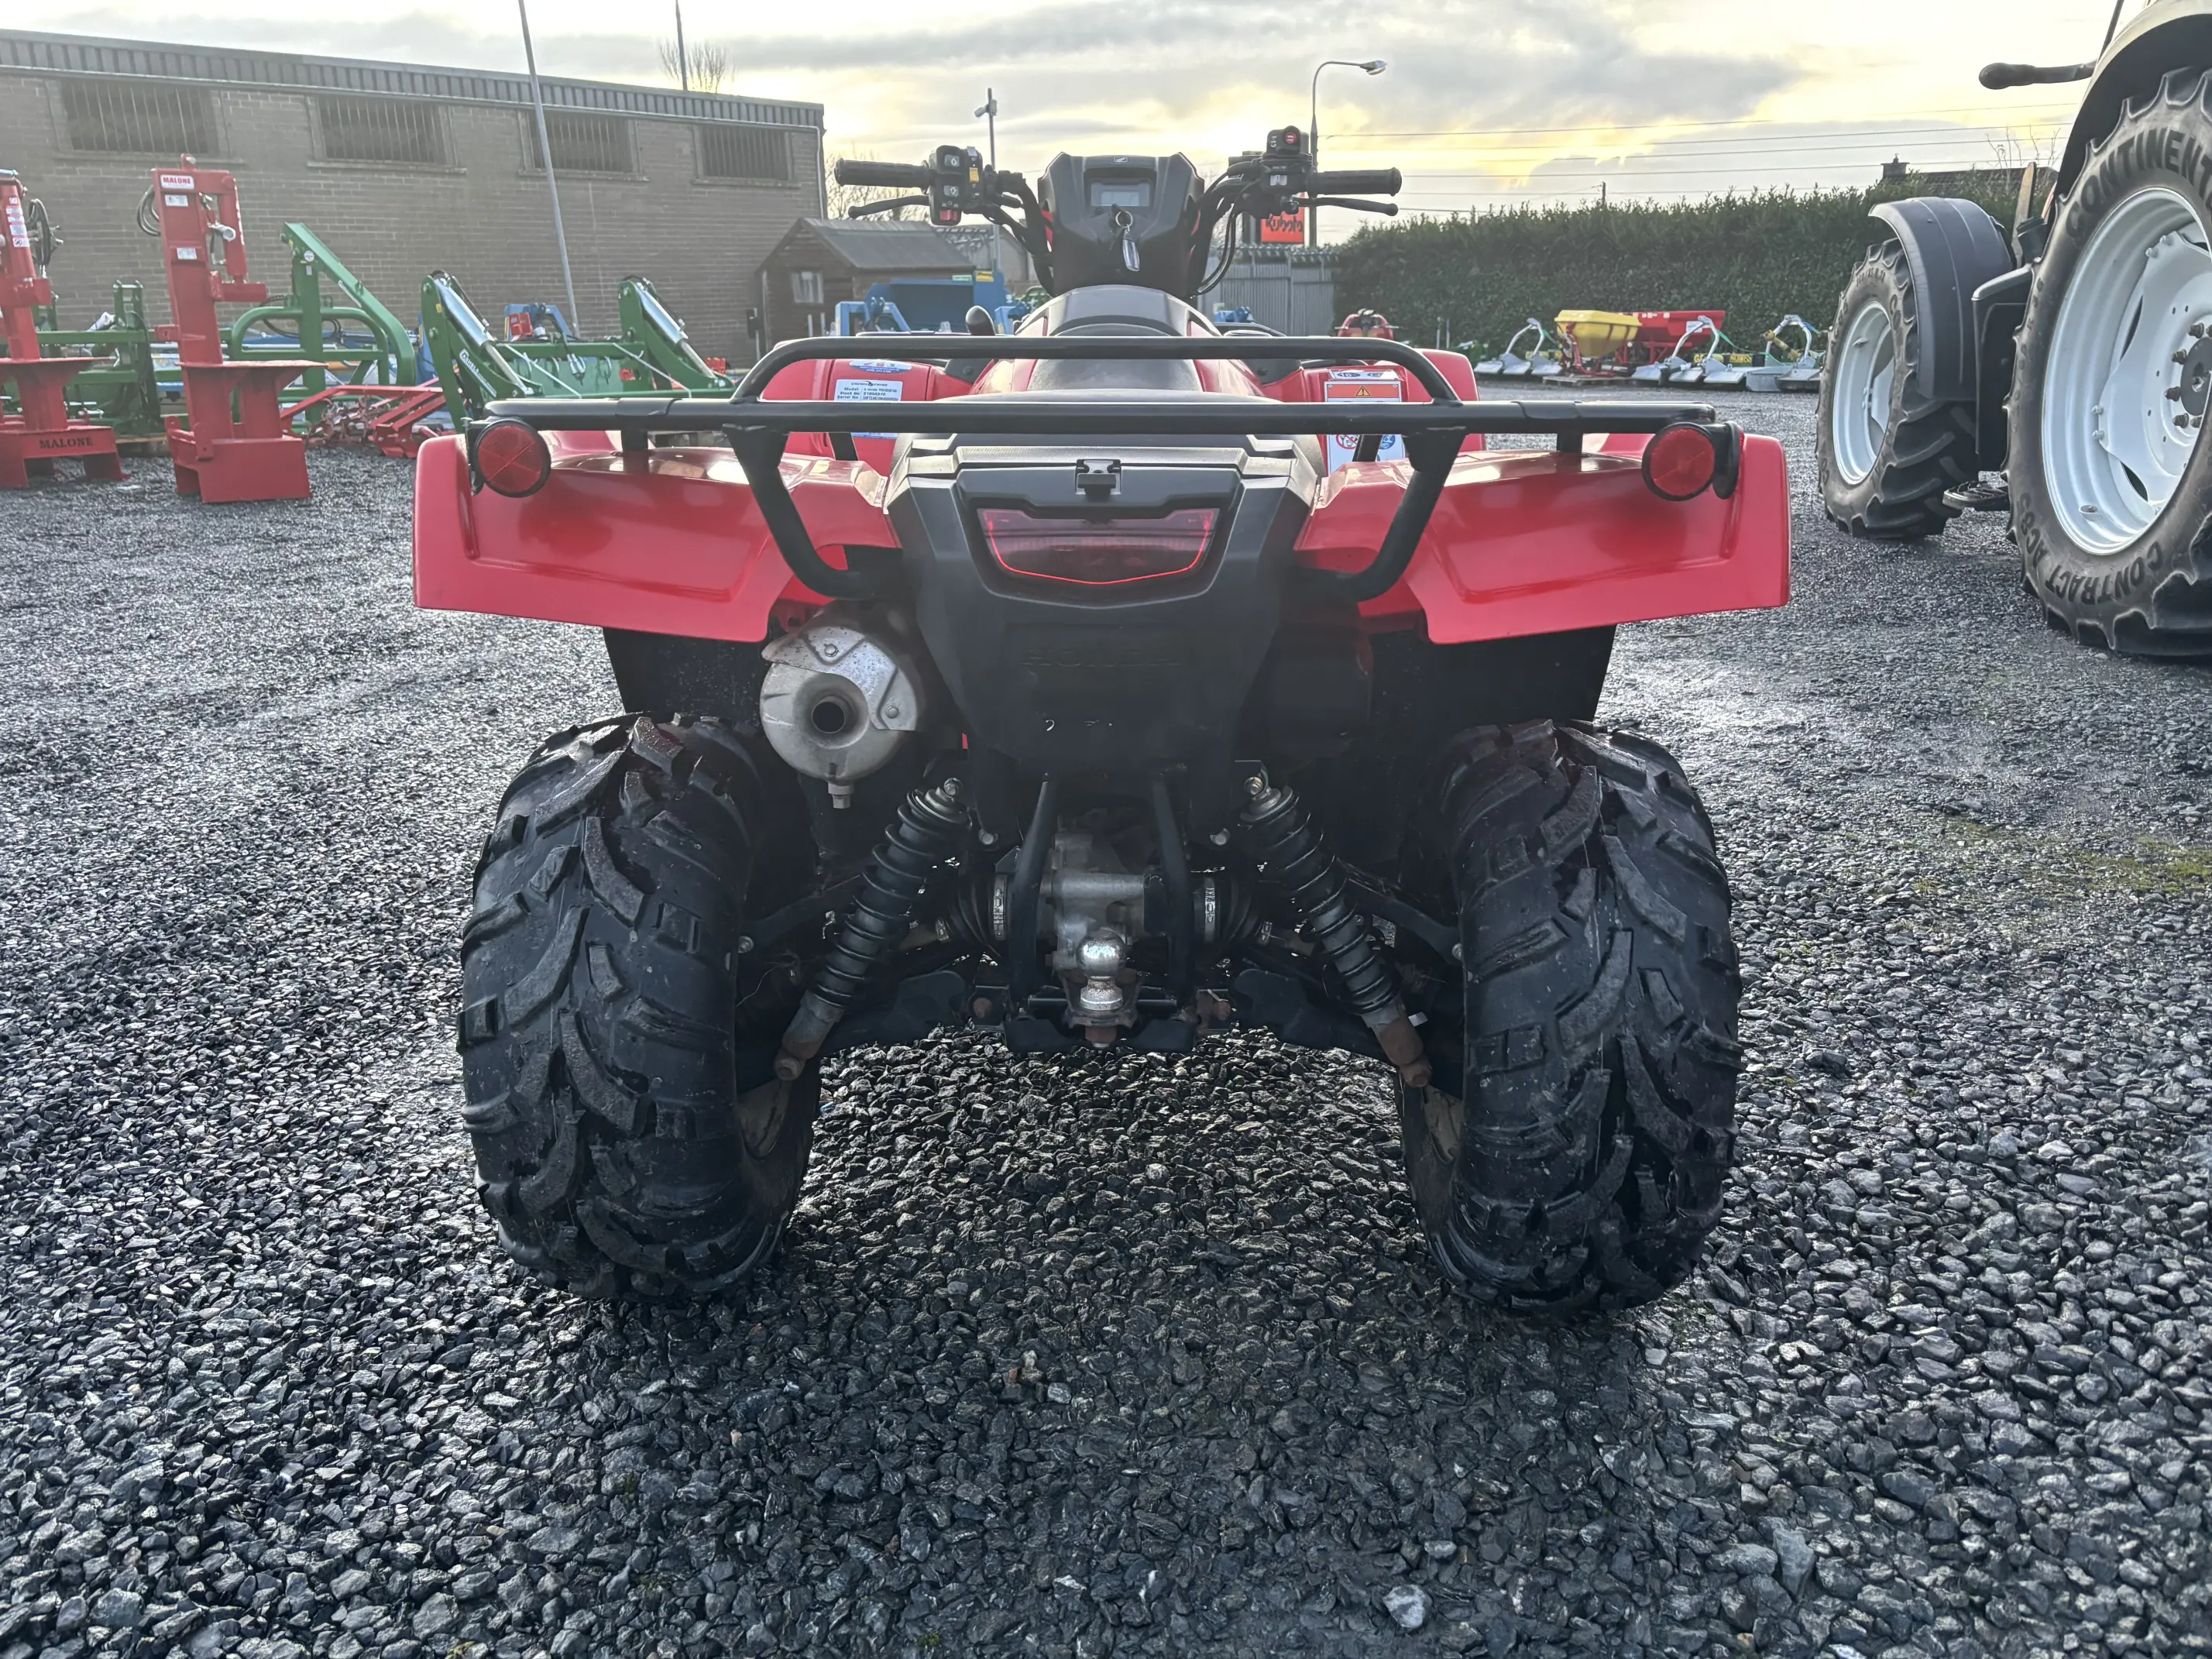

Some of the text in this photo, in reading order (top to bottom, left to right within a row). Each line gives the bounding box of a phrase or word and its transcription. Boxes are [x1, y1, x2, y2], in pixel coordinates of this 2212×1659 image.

[2066, 127, 2212, 237] CONTINENT
[1266, 214, 1304, 232] Kubota
[40, 437, 93, 449] MALONE
[2045, 541, 2163, 605] CONTRACT
